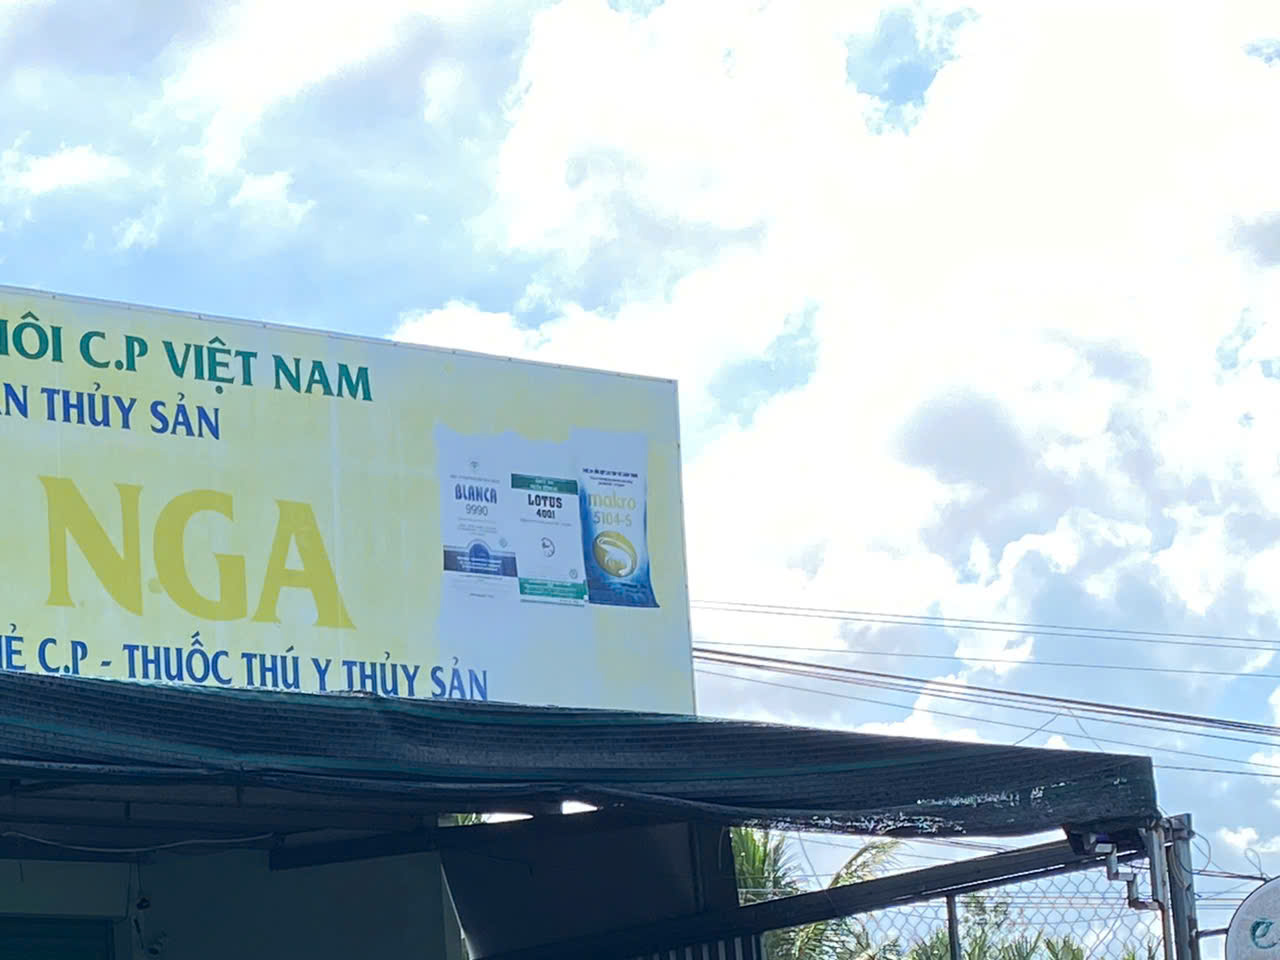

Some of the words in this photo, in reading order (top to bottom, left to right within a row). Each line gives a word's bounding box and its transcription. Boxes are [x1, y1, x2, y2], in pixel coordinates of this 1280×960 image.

[79, 328, 148, 373] C.P
[163, 336, 257, 394] VIỆT
[273, 356, 373, 401] NAM
[45, 384, 136, 432] THỦY
[150, 391, 221, 440] SẢN
[454, 483, 498, 504] BLANCA
[527, 494, 563, 509] LOTUS
[38, 474, 358, 630] NGA
[38, 638, 88, 675] C.P
[123, 631, 232, 686] THUỐC
[241, 645, 301, 690] THÚ
[311, 658, 333, 692] Y
[342, 652, 420, 698] THỦY
[430, 656, 488, 701] SẢN
